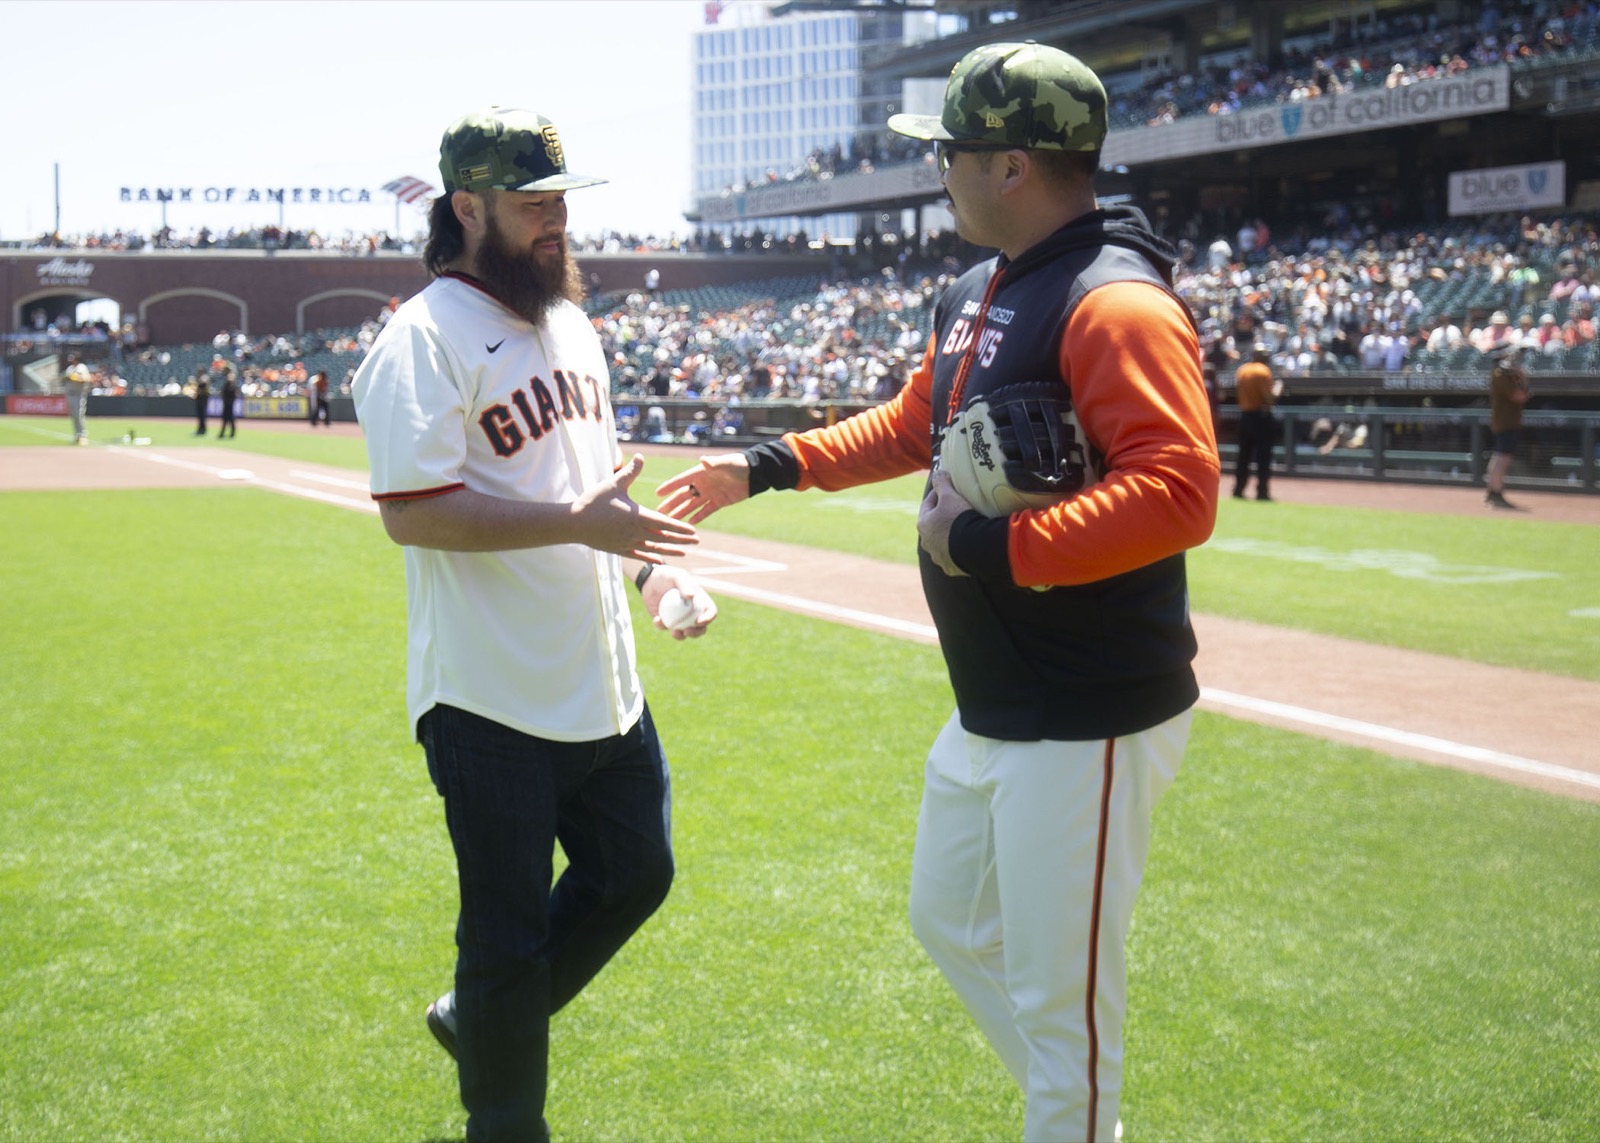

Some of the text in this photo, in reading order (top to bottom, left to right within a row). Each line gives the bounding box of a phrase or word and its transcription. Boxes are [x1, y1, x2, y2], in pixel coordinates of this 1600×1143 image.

[1215, 76, 1495, 143] blue of california
[119, 186, 372, 203] BANK OF AMERICA
[1461, 172, 1521, 199] blue
[478, 369, 609, 459] GIANT
[970, 420, 996, 472] Rawlings
